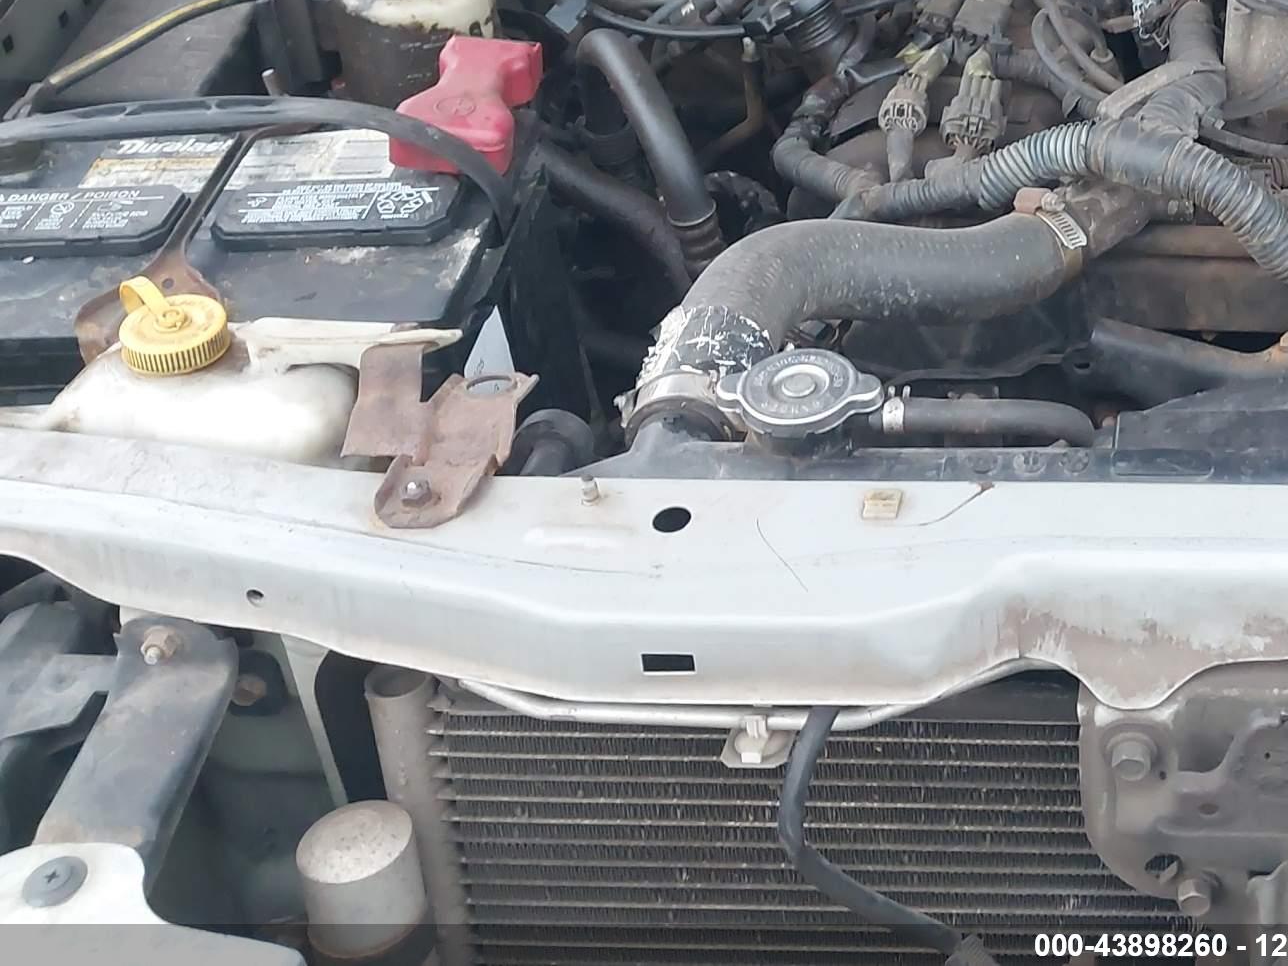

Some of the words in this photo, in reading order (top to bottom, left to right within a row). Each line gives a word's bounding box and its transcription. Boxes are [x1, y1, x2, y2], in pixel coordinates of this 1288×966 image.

[117, 138, 235, 156] Duralast
[7, 192, 69, 202] DANGER
[84, 189, 142, 200] POISON
